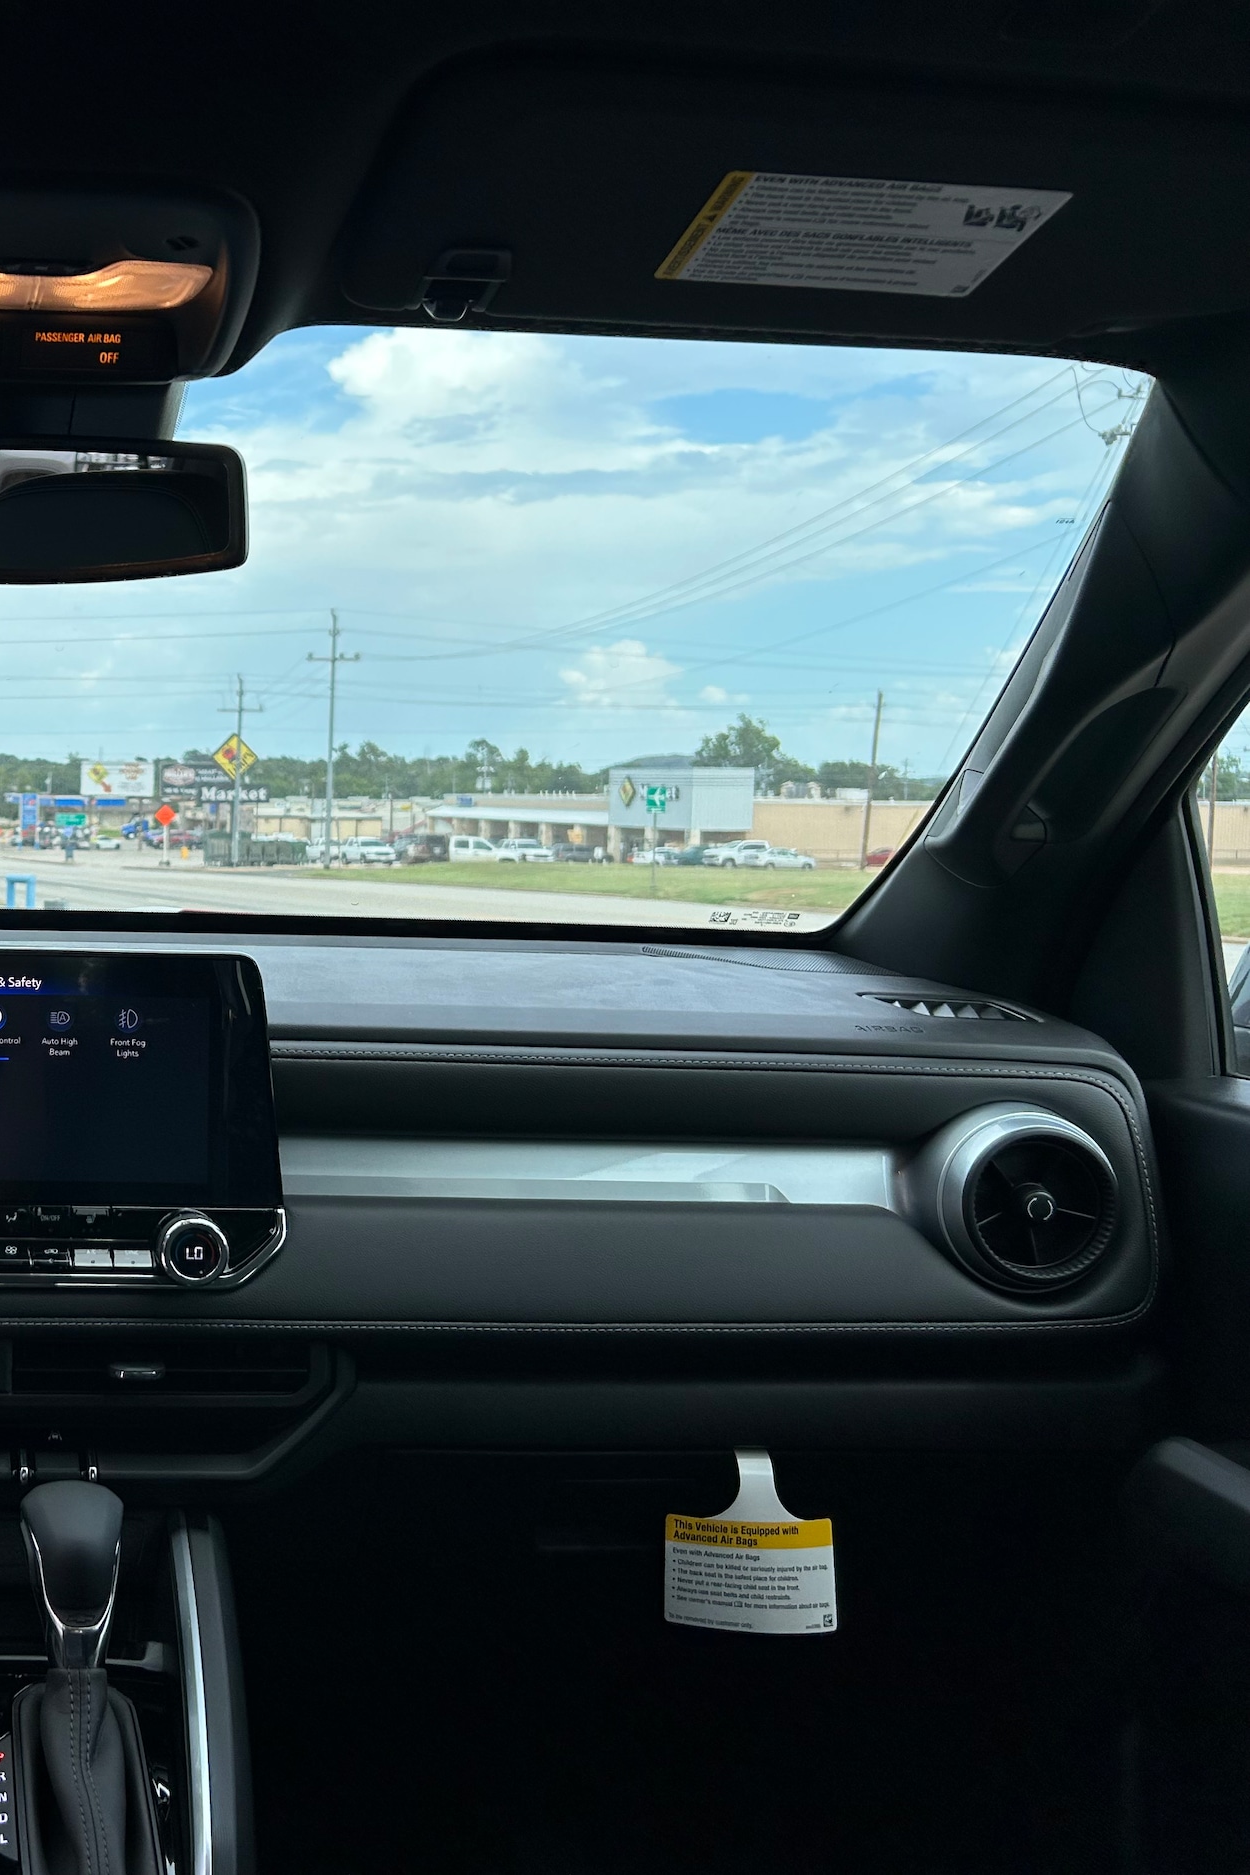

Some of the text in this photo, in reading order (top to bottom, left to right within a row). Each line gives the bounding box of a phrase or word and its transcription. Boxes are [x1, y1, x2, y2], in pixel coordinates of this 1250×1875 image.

[35, 331, 121, 344] PASSENGER AIR BAG
[99, 352, 120, 364] OFF
[201, 786, 268, 801] Market
[7, 975, 43, 991] Safety
[854, 1024, 926, 1034] AIRBAG
[41, 1037, 79, 1047] Auto High
[110, 1038, 147, 1049] Front Fog
[49, 1048, 71, 1056] Beam
[116, 1049, 140, 1059] Lights
[674, 1518, 799, 1538] This Vehicle is Equipped with
[673, 1530, 758, 1548] Advanced Air Bags
[672, 1547, 688, 1555] Even
[688, 1549, 702, 1557] with
[703, 1550, 734, 1559] Advanced
[745, 1554, 760, 1562] Bags
[677, 1558, 702, 1567] Children
[796, 1565, 803, 1573] by
[677, 1567, 688, 1575] The
[689, 1569, 703, 1577] back
[677, 1577, 693, 1585] Never
[694, 1579, 704, 1587] put
[710, 1581, 742, 1590] rear-facing
[0, 1833, 9, 1845] L
